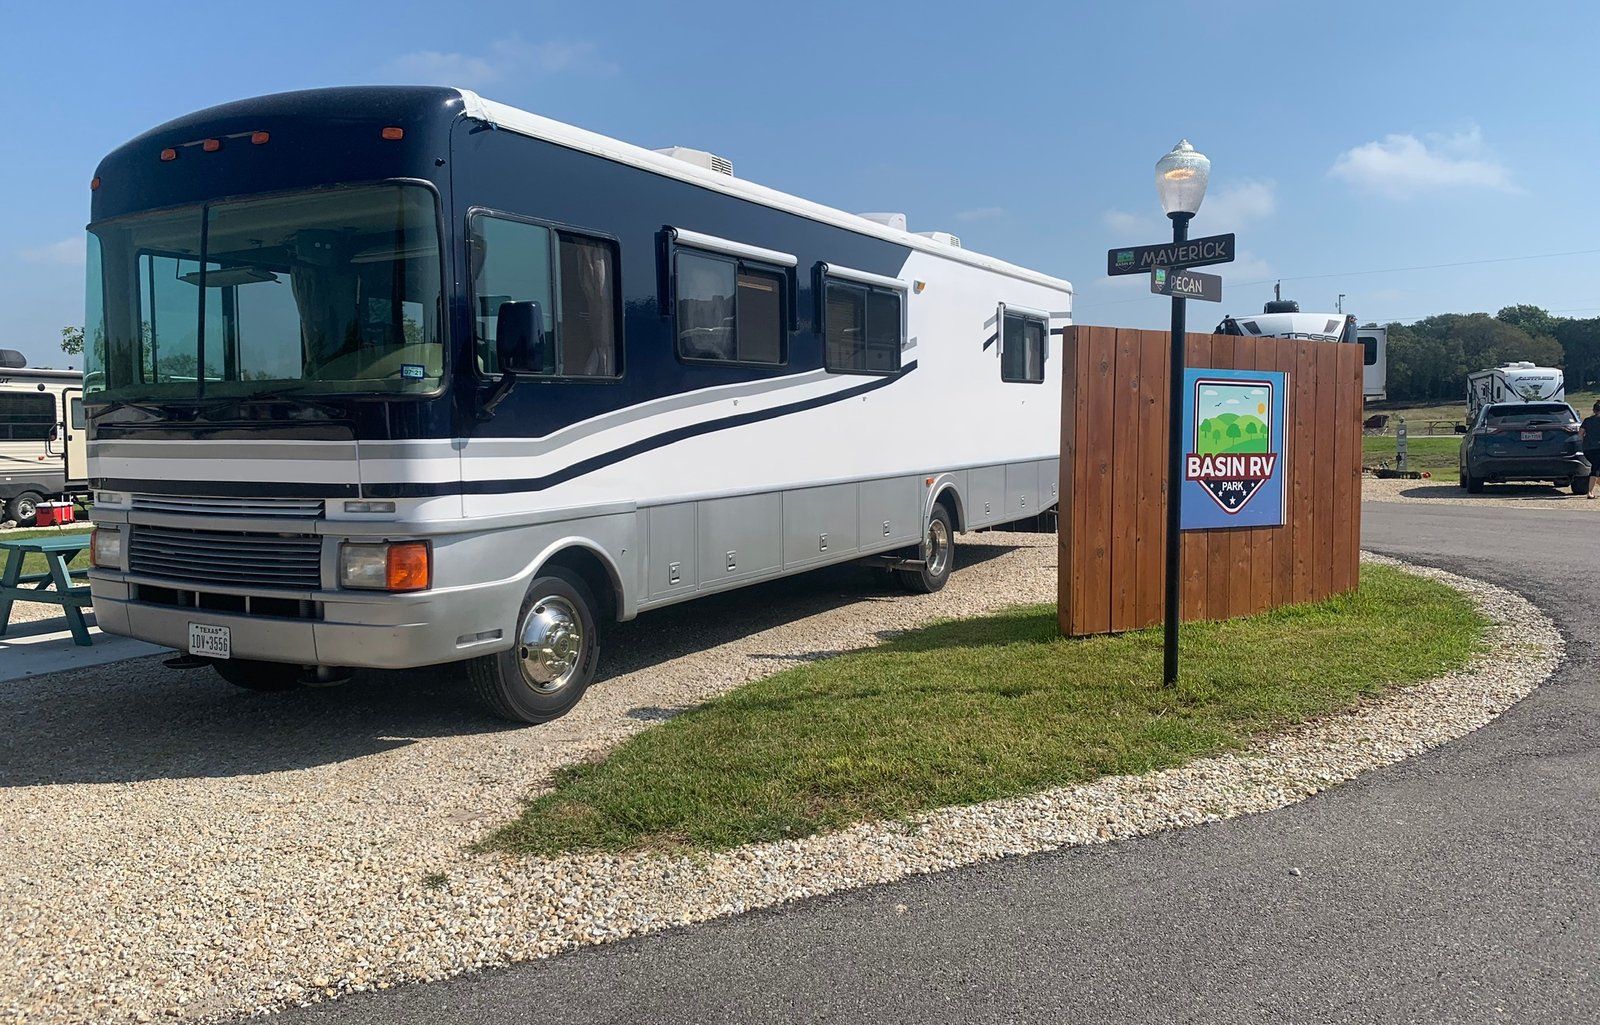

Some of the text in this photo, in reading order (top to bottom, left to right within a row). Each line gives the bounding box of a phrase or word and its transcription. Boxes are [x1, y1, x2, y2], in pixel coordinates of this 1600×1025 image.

[1141, 241, 1226, 266] MAVERICK
[1171, 275, 1202, 293] PECAN
[1188, 456, 1275, 478] BASIN RV
[1222, 481, 1245, 491] PARK
